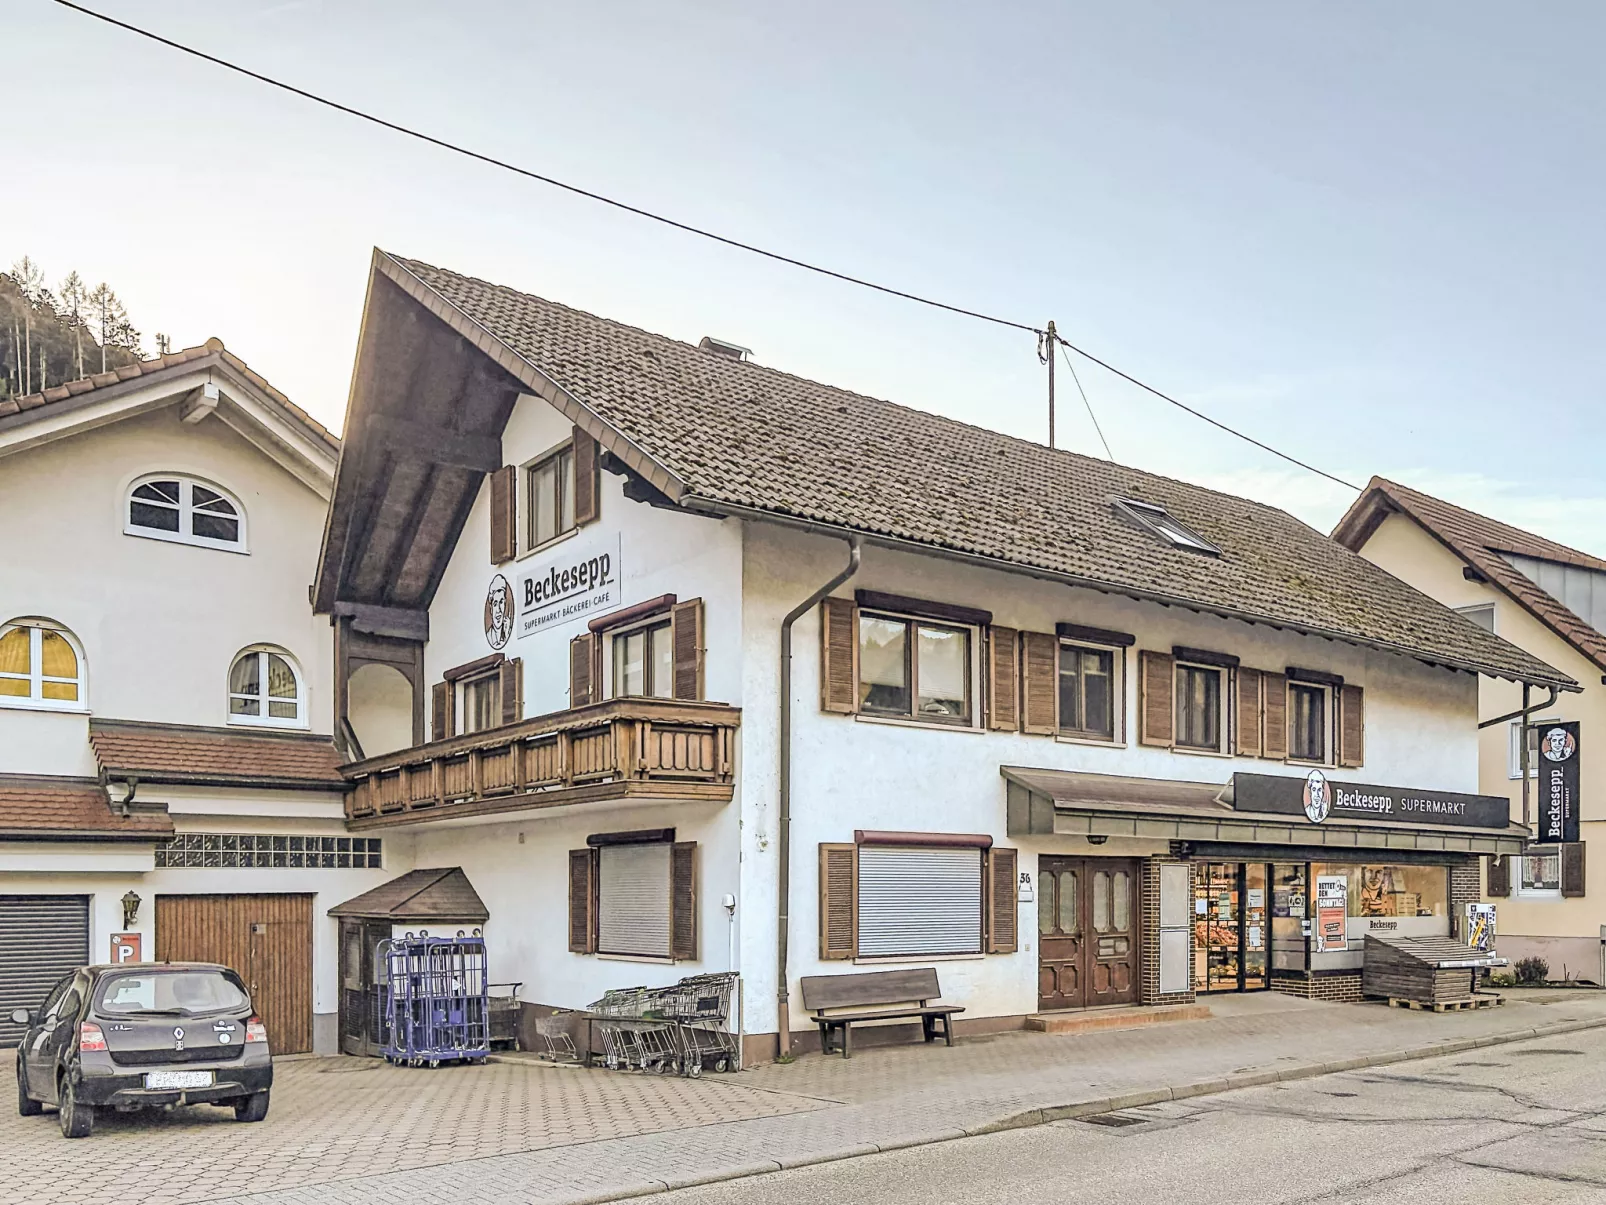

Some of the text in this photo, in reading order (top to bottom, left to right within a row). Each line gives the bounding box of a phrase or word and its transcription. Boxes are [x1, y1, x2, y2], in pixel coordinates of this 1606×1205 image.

[524, 552, 611, 607] Beckesepp
[524, 609, 561, 631] SUPERMARKT
[562, 599, 592, 617] BÄCKEREI
[1336, 788, 1466, 816] Beckesepp SUPERMARKT
[1547, 769, 1564, 837] Beckesepp
[1020, 872, 1031, 884] 36
[1369, 919, 1398, 931] Beckesepp
[118, 945, 134, 963] P
